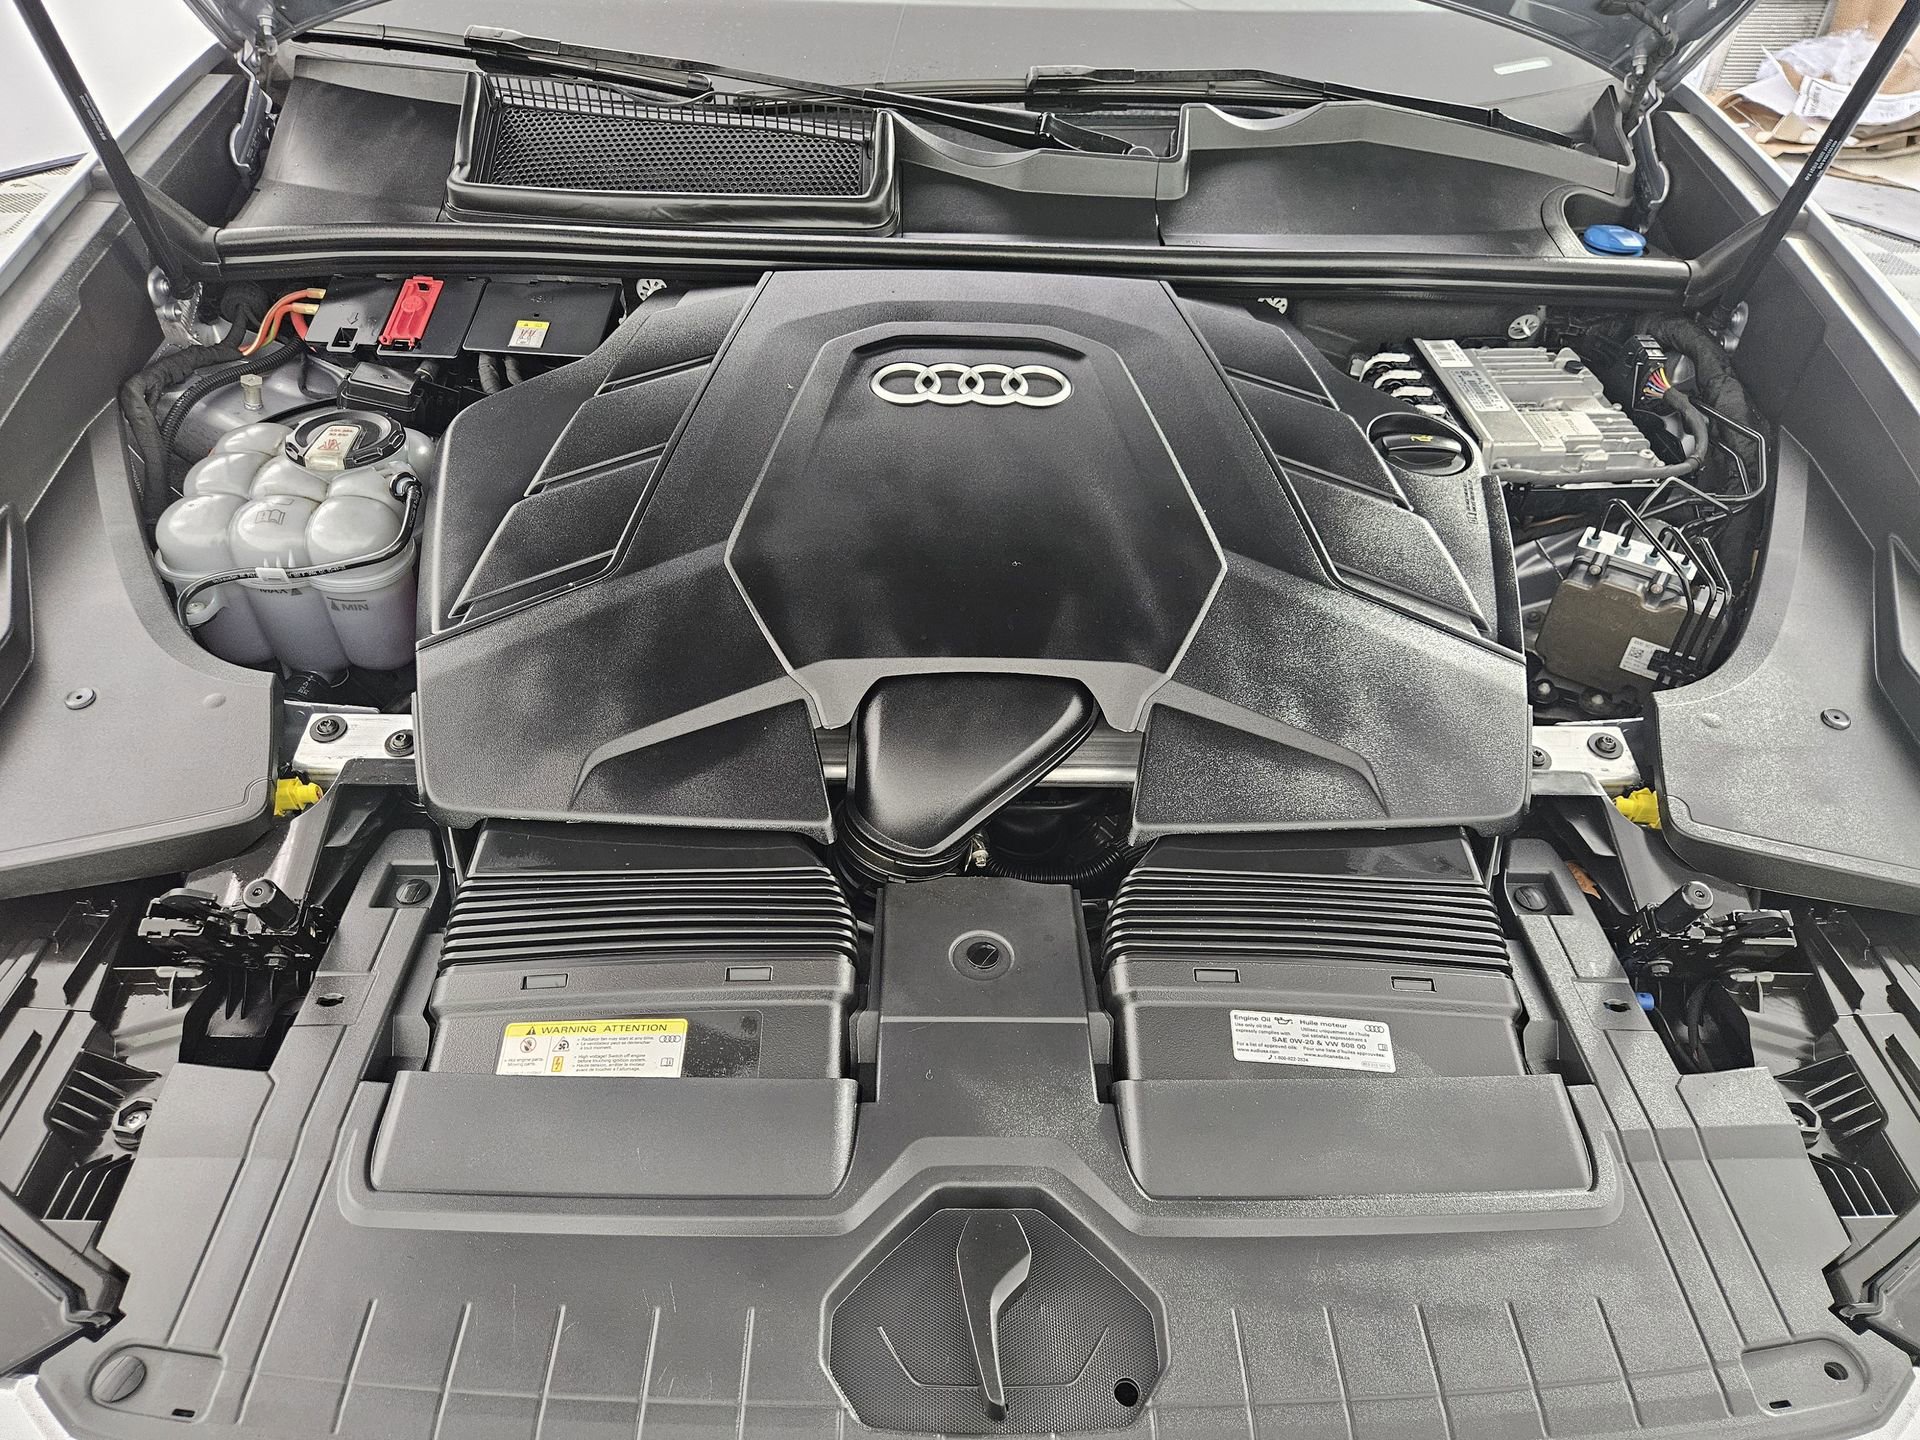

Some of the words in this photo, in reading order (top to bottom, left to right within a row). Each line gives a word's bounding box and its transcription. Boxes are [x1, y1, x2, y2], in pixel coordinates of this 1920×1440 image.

[341, 603, 370, 612] MIN
[1234, 1014, 1259, 1022] Engine
[541, 1025, 597, 1034] WARNING
[603, 1024, 668, 1033] ATTENTION
[1272, 1036, 1288, 1044] SAE
[1289, 1038, 1315, 1046] 0W-20
[1324, 1040, 1339, 1048] VW
